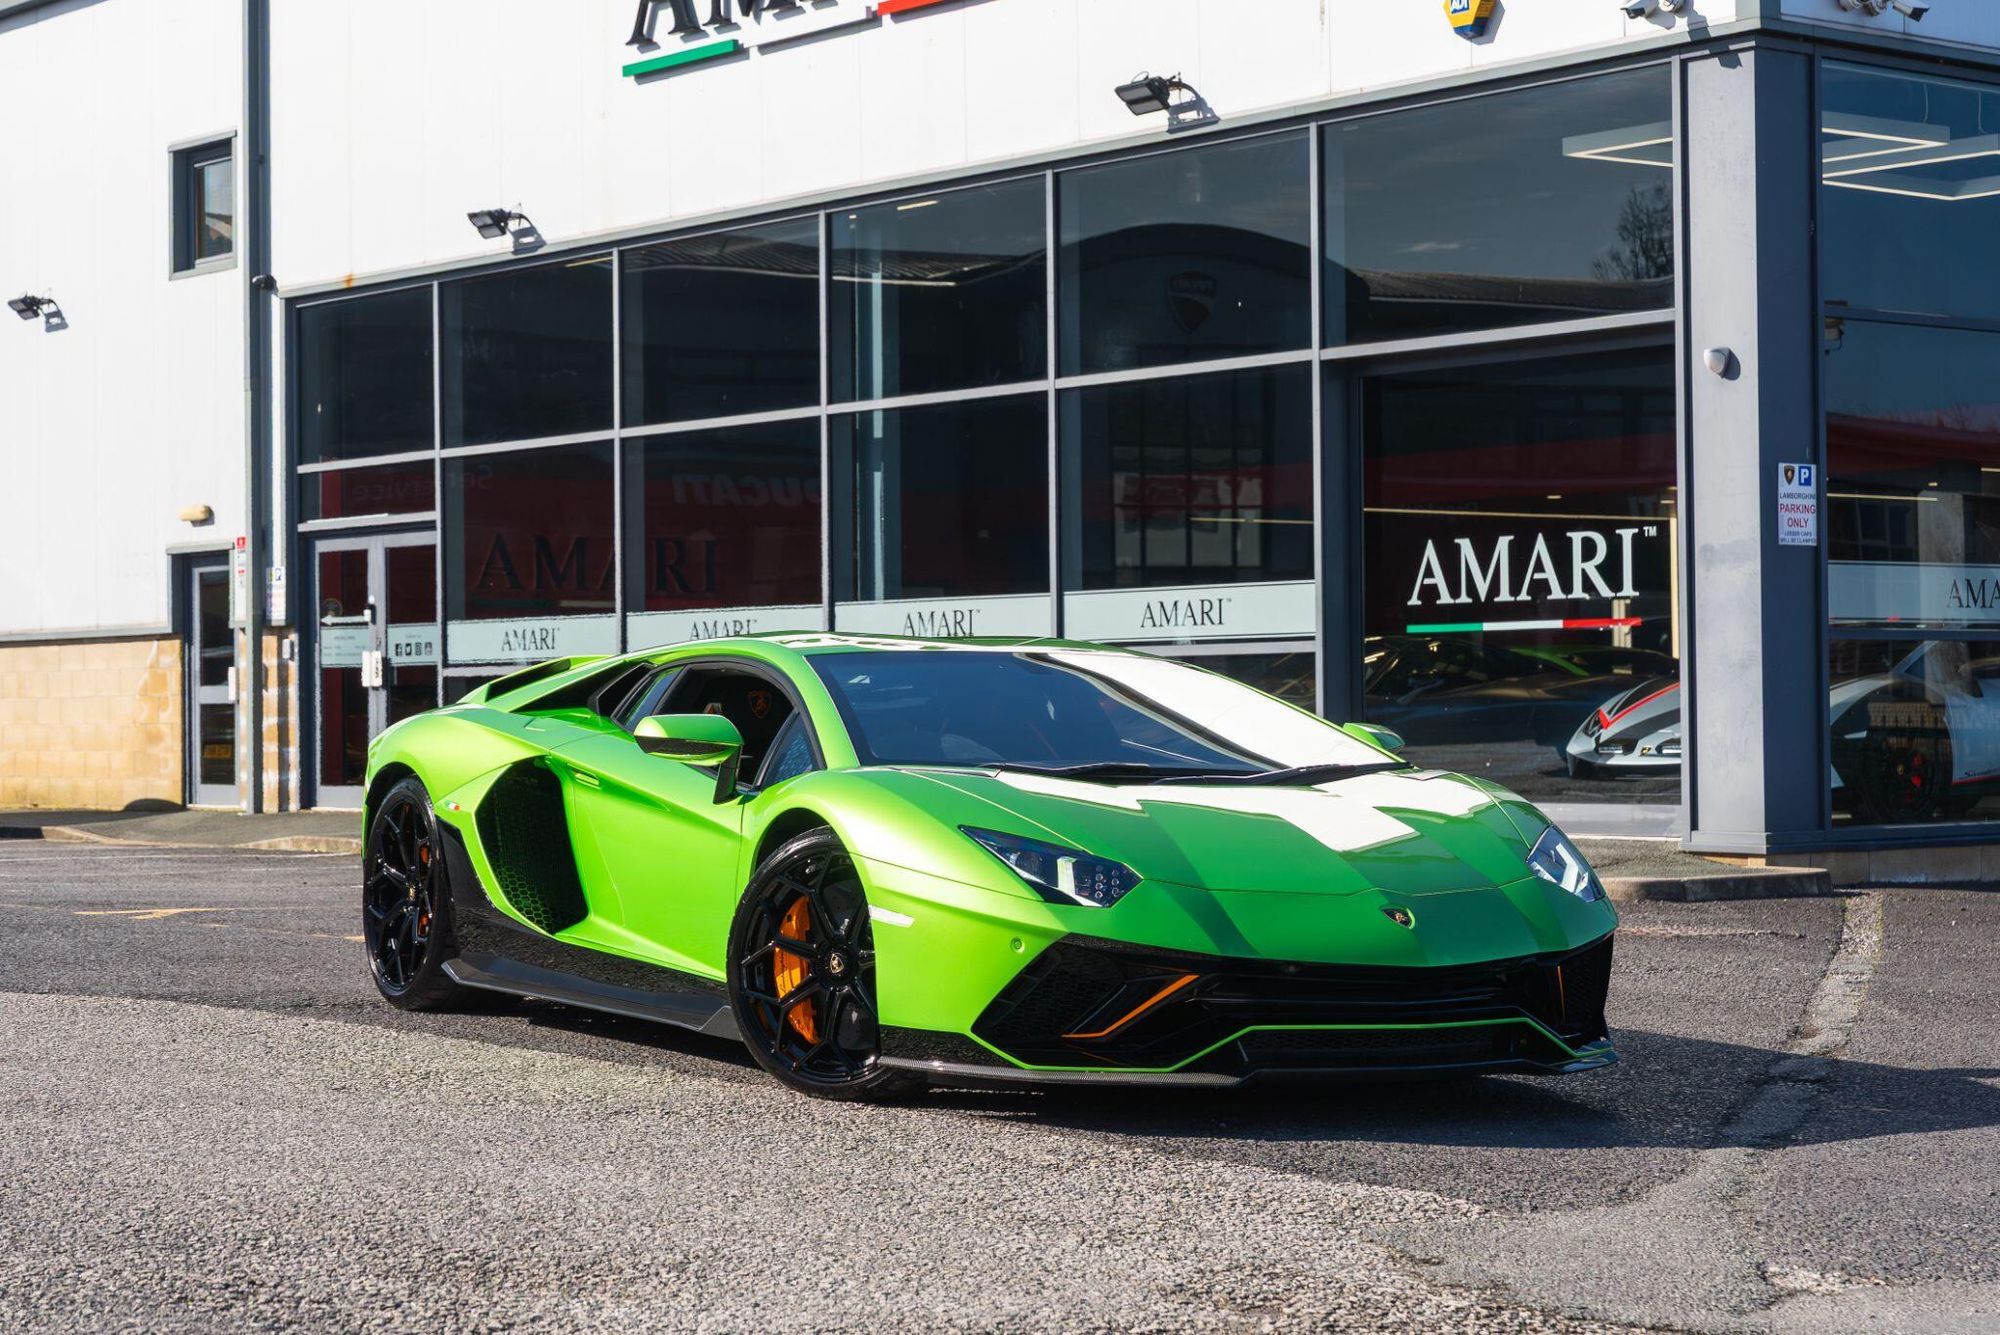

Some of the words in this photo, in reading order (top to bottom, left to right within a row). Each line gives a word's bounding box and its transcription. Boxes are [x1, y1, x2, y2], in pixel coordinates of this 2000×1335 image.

[1779, 503, 1816, 514] PARKING
[1787, 517, 1809, 528] ONLY
[1407, 528, 1640, 606] AMARI
[903, 609, 974, 637] AMARI
[1140, 598, 1224, 628] AMARI
[501, 627, 556, 652] AMARI
[690, 619, 751, 641] AMARI
